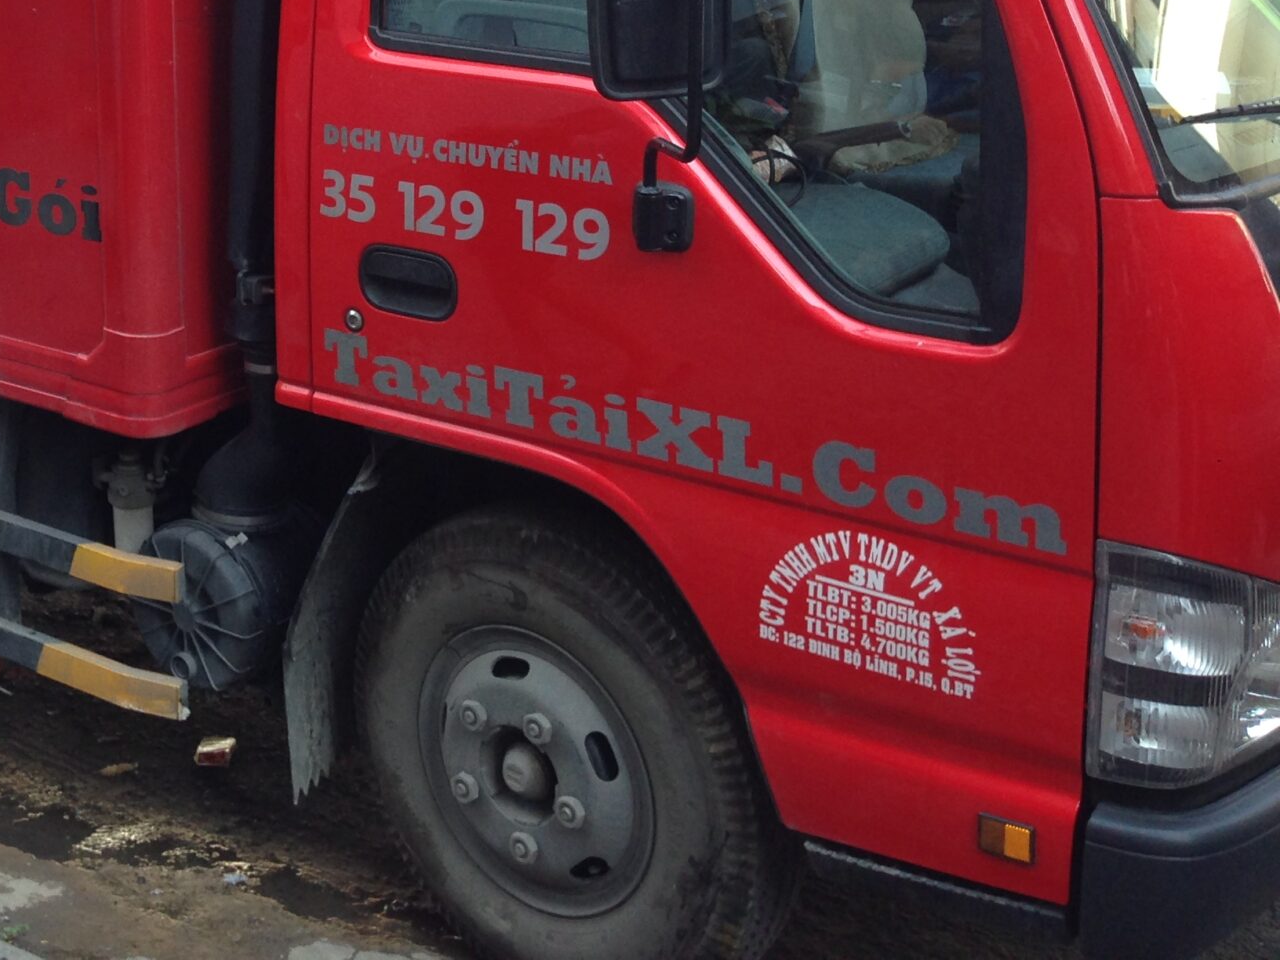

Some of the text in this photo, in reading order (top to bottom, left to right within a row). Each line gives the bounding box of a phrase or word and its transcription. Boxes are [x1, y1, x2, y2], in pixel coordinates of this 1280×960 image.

[323, 123, 382, 153] DỊCH
[433, 139, 539, 176] CHUYỂN
[549, 153, 614, 186] NHÀ
[320, 168, 611, 262] 35 129 129
[323, 328, 1069, 557] TaxiTảiXL.Com
[769, 542, 817, 593] TNHH
[810, 530, 851, 565] MTV
[857, 532, 915, 577] TMDV
[848, 564, 886, 592] 3N
[910, 565, 943, 600] VT
[759, 585, 788, 626] CTY
[806, 579, 931, 630] TLBT: 3.005KG
[806, 598, 930, 648] TLCP: 1.500KG
[783, 631, 806, 651] 122
[804, 616, 930, 667] TLTB: 4.700KG
